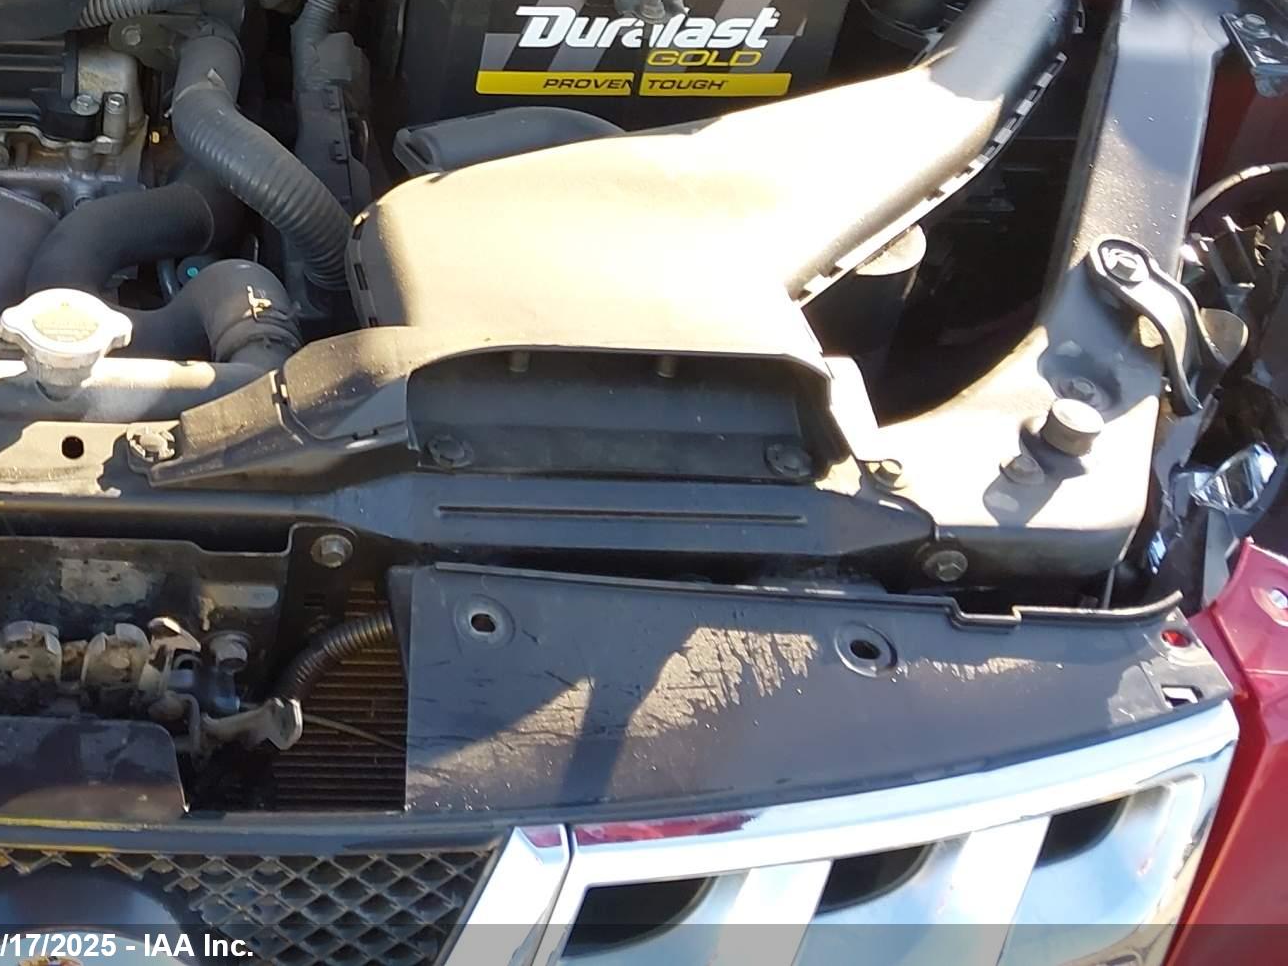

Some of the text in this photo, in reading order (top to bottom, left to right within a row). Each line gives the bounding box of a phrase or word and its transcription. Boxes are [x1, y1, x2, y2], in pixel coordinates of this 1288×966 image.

[515, 6, 780, 49] Duralast
[647, 50, 762, 67] GOLD
[648, 79, 724, 91] TOUGH
